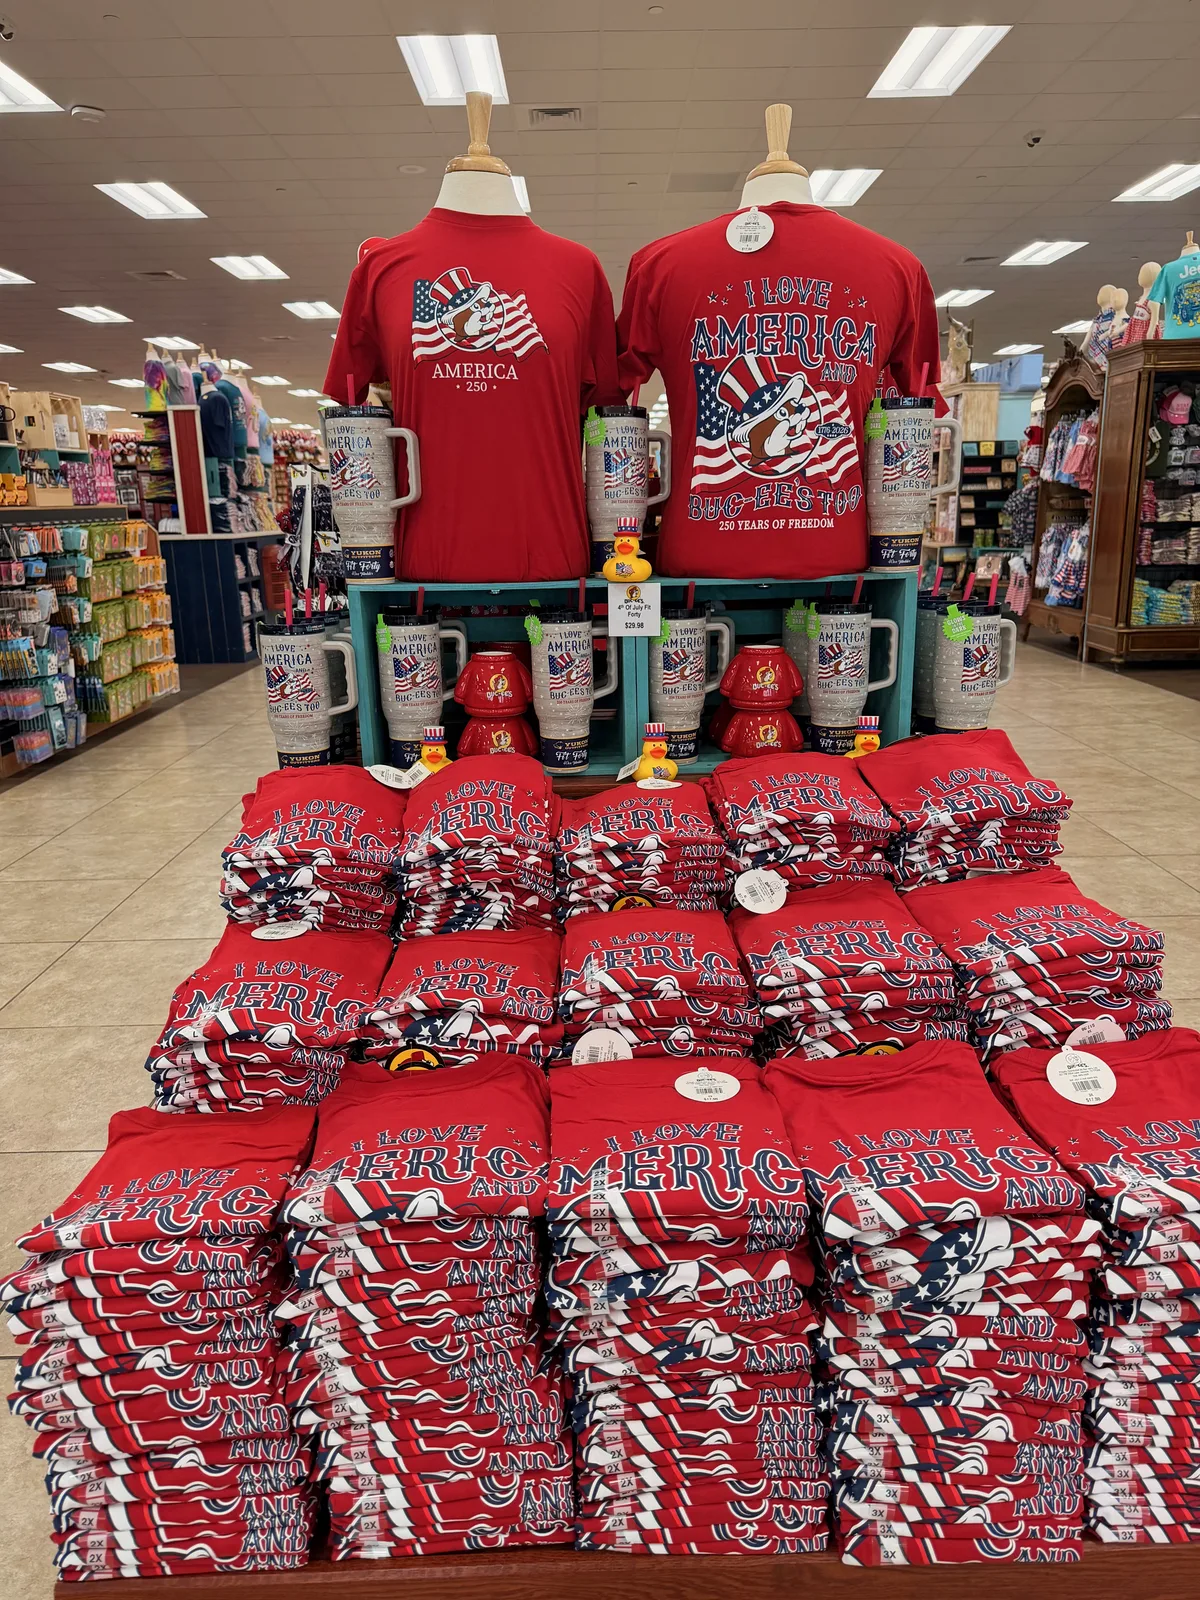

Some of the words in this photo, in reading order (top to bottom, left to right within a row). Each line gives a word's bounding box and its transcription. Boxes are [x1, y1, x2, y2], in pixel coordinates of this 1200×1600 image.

[744, 279, 755, 308] I
[761, 275, 833, 310] LOVE
[690, 312, 877, 368] AMERICA
[432, 363, 519, 380] AMERICA
[820, 361, 858, 384] AND
[466, 381, 487, 392] 250
[903, 418, 922, 426] LOVE
[336, 425, 356, 434] LOVE
[622, 425, 639, 435] LOVE
[884, 428, 931, 443] AMERICA
[604, 436, 646, 452] AMERICA
[363, 488, 381, 499] TOO
[688, 477, 813, 521] BUC-EE'S
[818, 485, 863, 516] TOO
[719, 520, 735, 531] 250
[737, 519, 769, 531] YEARS
[772, 519, 785, 529] OF
[788, 517, 835, 529] FREEDOM
[899, 548, 917, 560] Forty
[359, 560, 381, 573] Forty
[836, 622, 854, 630] LOVE
[946, 616, 966, 625] GLOWS
[984, 623, 998, 632] LOVE
[564, 631, 582, 639] LOVE
[679, 627, 698, 636] LOVE
[951, 626, 967, 634] DARK
[409, 634, 427, 642] LOVE
[662, 636, 706, 650] AMERICA
[818, 632, 865, 646] AMERICA
[275, 644, 296, 652] LOVE
[392, 642, 437, 657] AMERICA
[548, 640, 591, 654] AMERICA
[264, 653, 313, 669] AMERICA
[305, 701, 320, 712] TOO
[749, 779, 764, 793] I
[766, 771, 840, 789] LOVE
[916, 787, 935, 800] I
[931, 767, 1012, 793] LOVE
[432, 800, 440, 814] I
[445, 780, 516, 802] LOVE
[273, 808, 283, 825] I
[290, 799, 367, 825] LOVE
[588, 809, 598, 819] I
[605, 797, 674, 812] LOVE
[228, 884, 233, 892] S
[971, 918, 997, 931] I
[993, 904, 1094, 925] LOVE
[771, 929, 790, 938] I
[793, 919, 886, 934] LOVE
[590, 939, 602, 949] I
[610, 931, 696, 946] LOVE
[414, 965, 424, 978] I
[433, 957, 520, 977] LOVE
[994, 959, 1007, 969] XL
[233, 962, 246, 979] I
[255, 960, 344, 989] LOVE
[697, 971, 750, 987] AND
[783, 970, 796, 979] XL
[786, 987, 798, 995] XL
[500, 996, 554, 1022] AND
[607, 1011, 614, 1019] L
[818, 1025, 830, 1033] XL
[350, 1140, 364, 1152] I
[376, 1124, 488, 1148] LOVE
[604, 1135, 622, 1153] I
[631, 1122, 743, 1147] LOVE
[1092, 1128, 1128, 1150] I
[1116, 1118, 1200, 1147] LOV
[832, 1138, 856, 1160] I
[855, 1128, 976, 1152] LOVE
[97, 1184, 114, 1199] I
[123, 1168, 240, 1195] LOVE
[467, 1176, 541, 1199] AND
[1004, 1175, 1077, 1210] AND
[309, 1213, 323, 1223] 2X
[592, 1209, 606, 1218] 2X
[862, 1215, 877, 1226] 3X
[65, 1231, 79, 1241] 2X
[1163, 1250, 1176, 1260] 3X
[877, 1295, 890, 1305] 3X
[601, 1347, 615, 1357] 2X
[743, 1342, 810, 1371] AND
[998, 1350, 1073, 1373] AND
[192, 1358, 264, 1388] AND
[44, 1393, 59, 1404] 2X
[221, 1403, 291, 1440] AND
[876, 1414, 890, 1423] 3X
[1130, 1419, 1143, 1427] 3X
[67, 1442, 82, 1453] 2X
[228, 1434, 300, 1461] AND
[361, 1477, 374, 1487] 2X
[1013, 1494, 1082, 1517] AND
[1121, 1531, 1134, 1540] 3X
[883, 1549, 897, 1559] 3X
